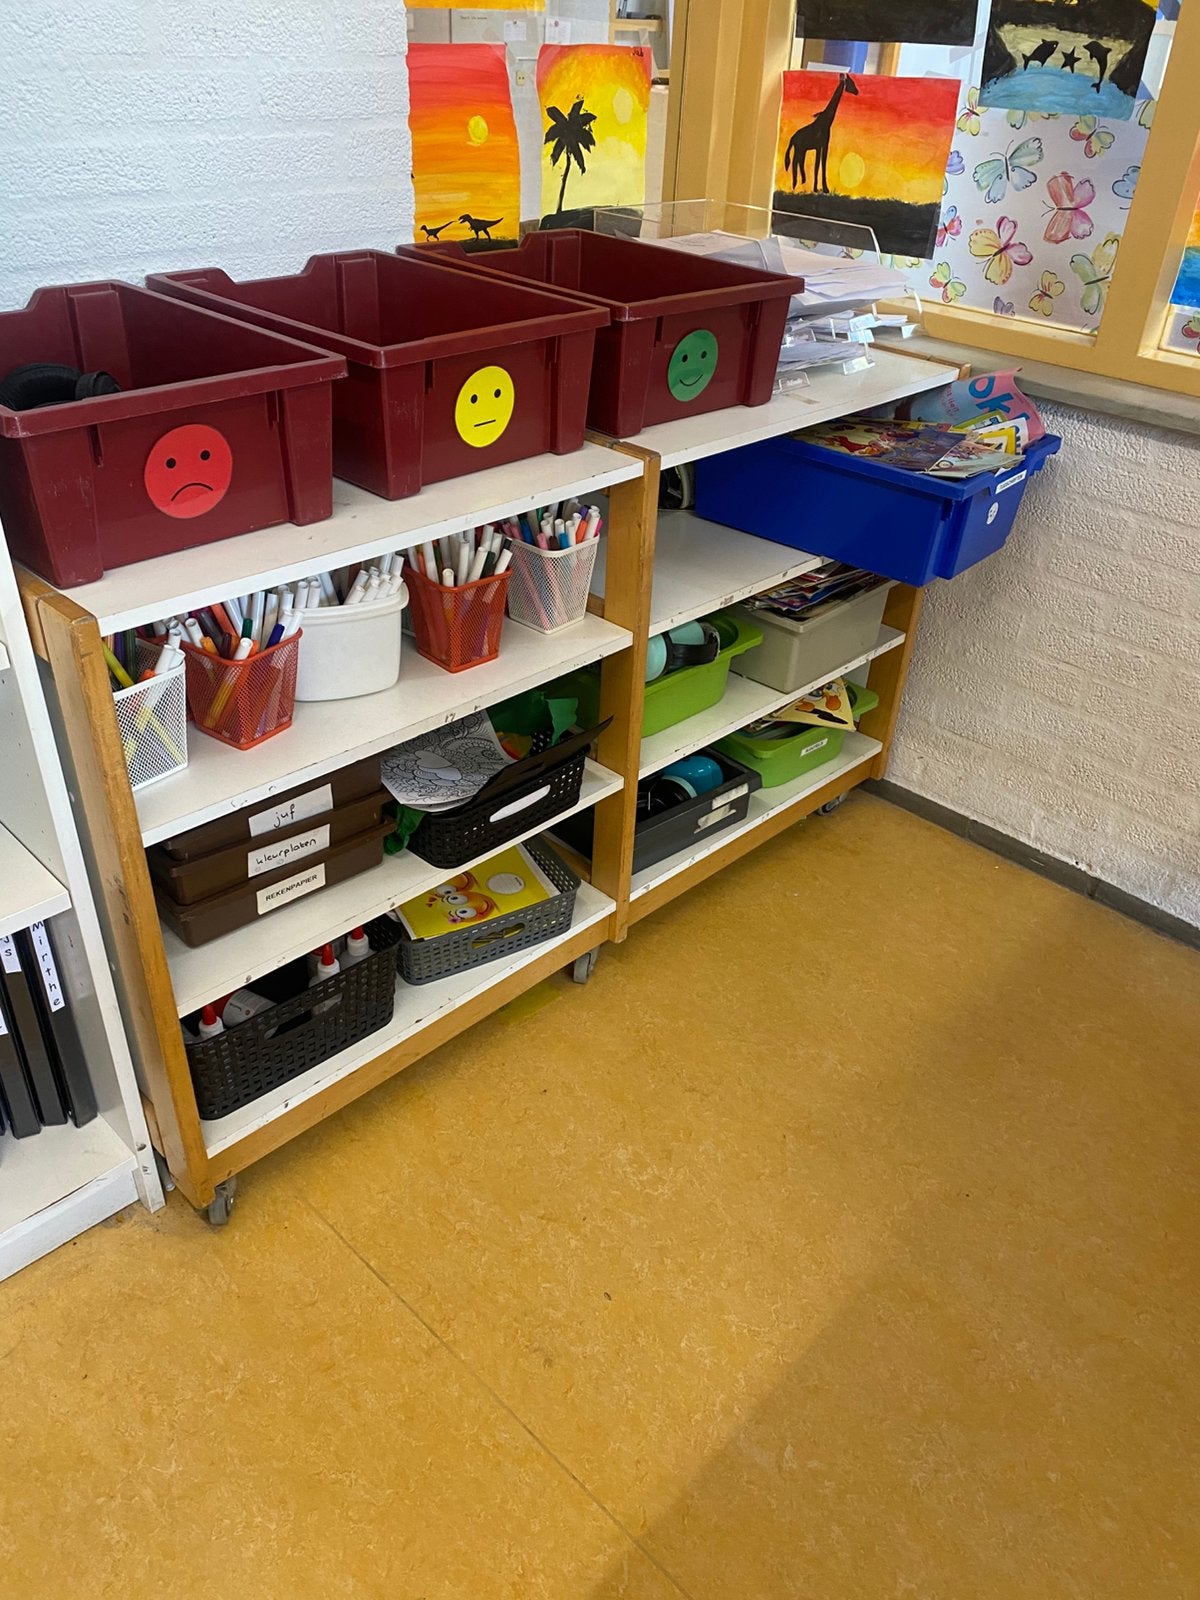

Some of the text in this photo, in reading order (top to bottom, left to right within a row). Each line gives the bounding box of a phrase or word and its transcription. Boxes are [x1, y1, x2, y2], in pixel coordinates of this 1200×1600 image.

[274, 803, 295, 829] juf
[256, 838, 317, 865] kleurplaten
[265, 874, 318, 902] REKENPAPIER
[32, 921, 61, 1006] Mirthe
